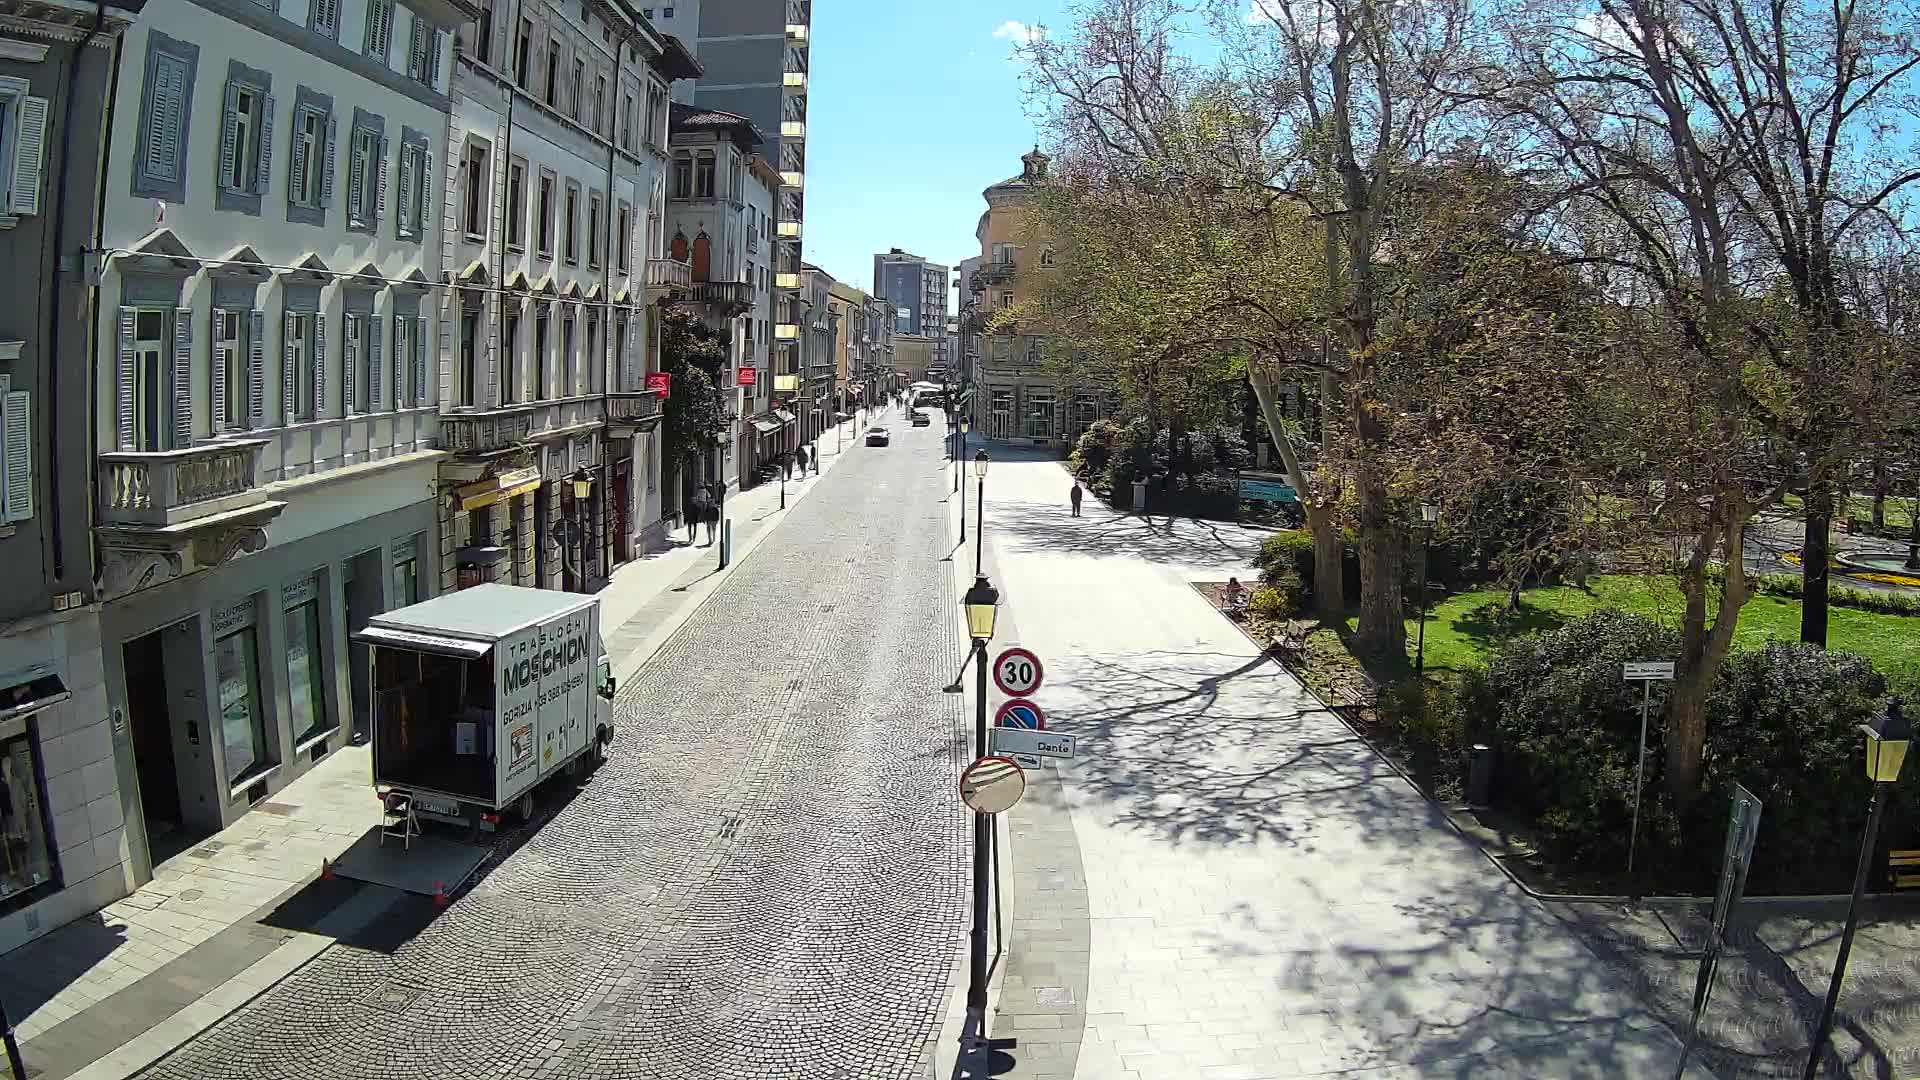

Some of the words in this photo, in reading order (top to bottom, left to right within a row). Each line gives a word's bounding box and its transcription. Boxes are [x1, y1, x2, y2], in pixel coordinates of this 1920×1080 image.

[509, 619, 587, 658] TRASLOCHI
[503, 632, 590, 697] MOSCHION
[1004, 661, 1032, 684] 30
[503, 700, 532, 725] GORIZIA
[1037, 742, 1069, 753] Dante
